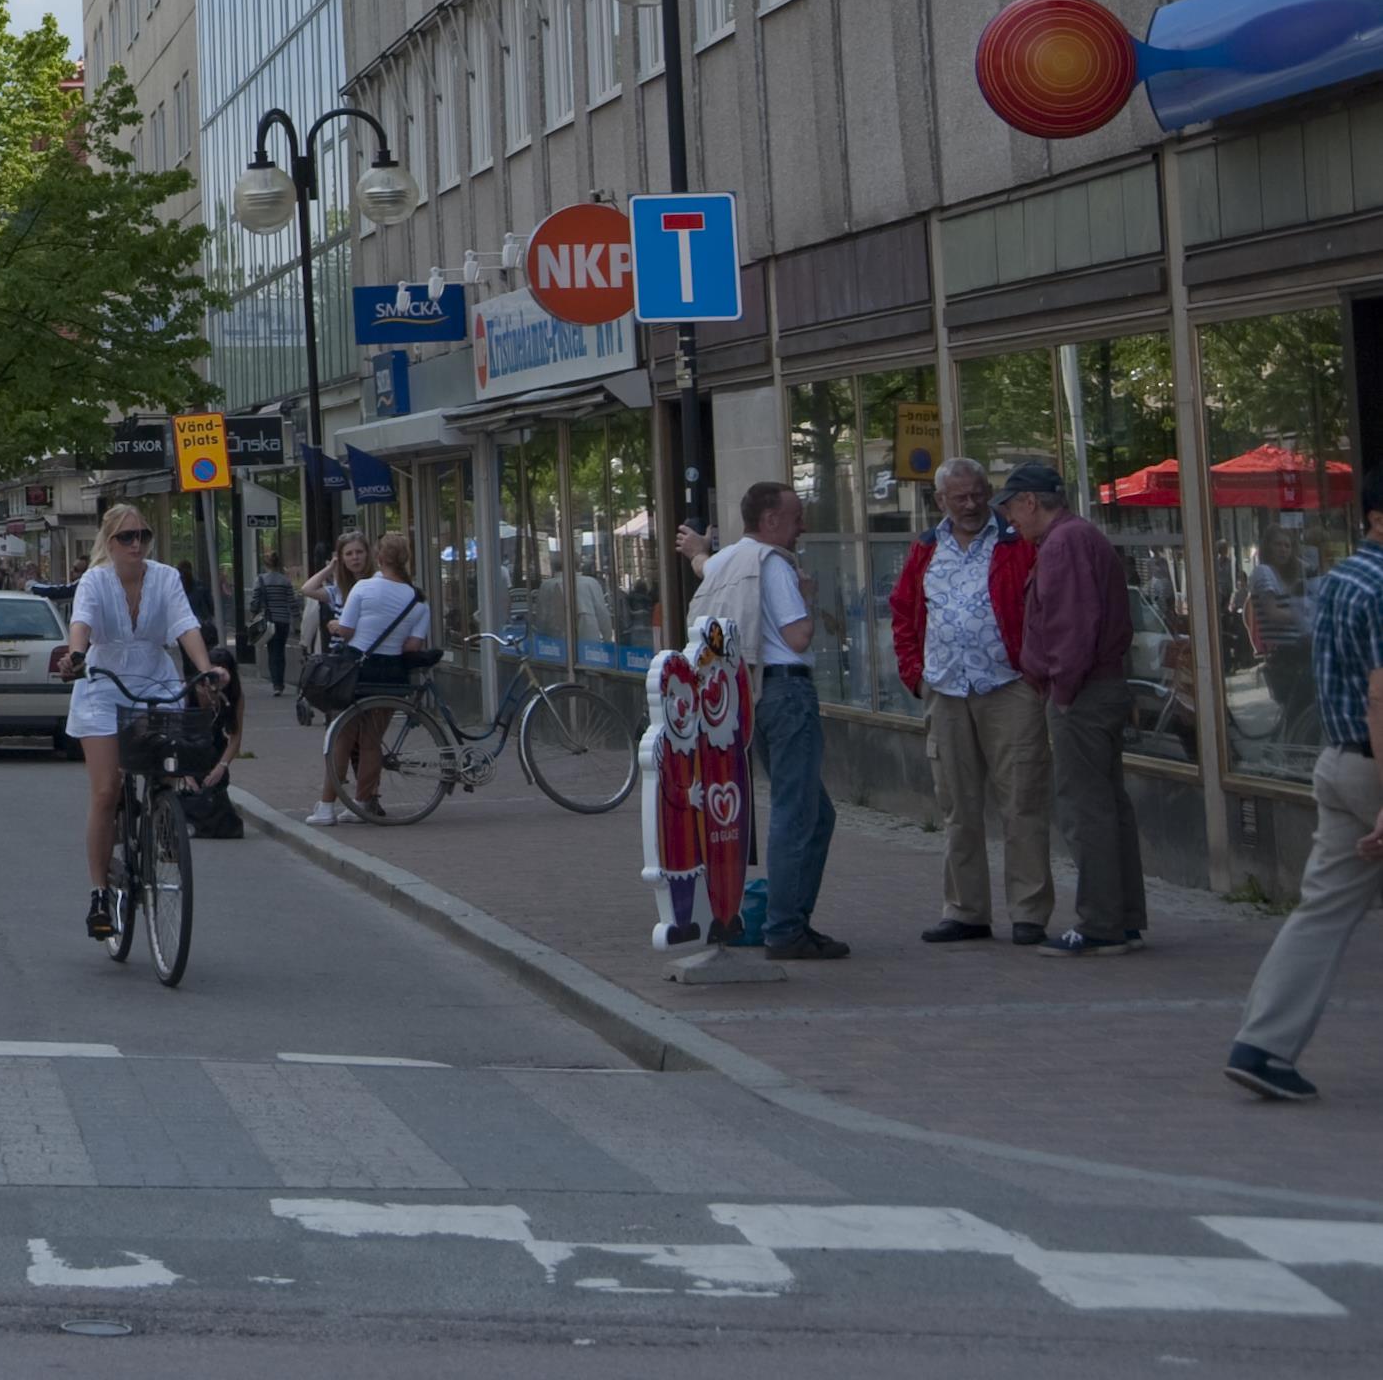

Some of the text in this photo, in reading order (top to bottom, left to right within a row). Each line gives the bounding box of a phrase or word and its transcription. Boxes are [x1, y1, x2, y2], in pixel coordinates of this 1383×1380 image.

[537, 244, 633, 289] NKP
[176, 421, 223, 434] Vänd-
[132, 440, 163, 453] SKOR
[183, 435, 219, 449] plats
[227, 430, 281, 453] Önska
[357, 484, 392, 495] SMYCKA
